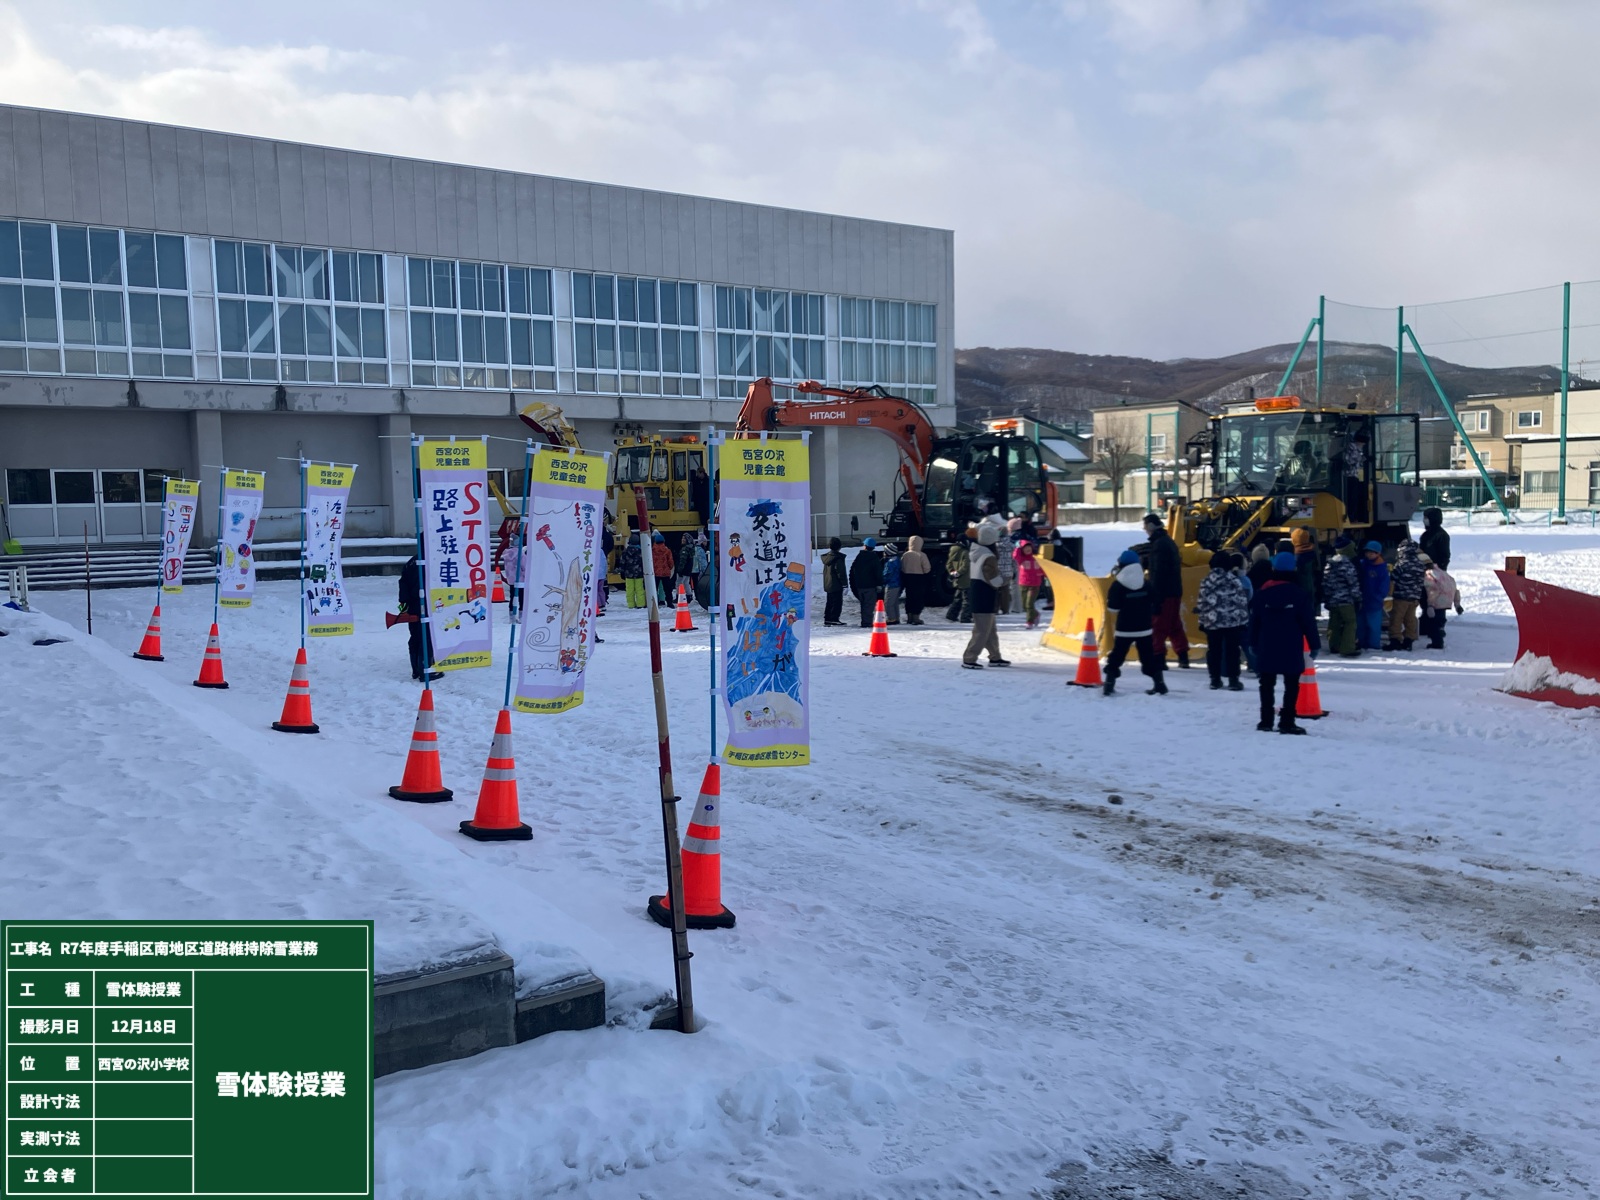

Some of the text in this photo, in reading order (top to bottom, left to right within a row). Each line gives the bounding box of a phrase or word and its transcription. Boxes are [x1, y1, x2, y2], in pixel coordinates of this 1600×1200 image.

[810, 411, 846, 420] HITACHI
[436, 447, 470, 456] 西宮の沢
[742, 449, 785, 461] 西宮の沢
[436, 457, 470, 466] 児童会館
[551, 458, 588, 473] 西宮の沢
[320, 470, 344, 479] 西宮の沢
[549, 470, 587, 484] 児童会館
[743, 464, 786, 477] 児童会館
[320, 478, 343, 486] 児童会館
[432, 488, 459, 587] 路上駐車
[461, 481, 487, 596] STOP
[753, 512, 775, 585] 冬道は
[771, 513, 788, 582] ふゆみち
[740, 597, 768, 677] いっぱい
[769, 589, 793, 674] キケンが
[728, 749, 806, 762] 手稲区南地区除雪センター
